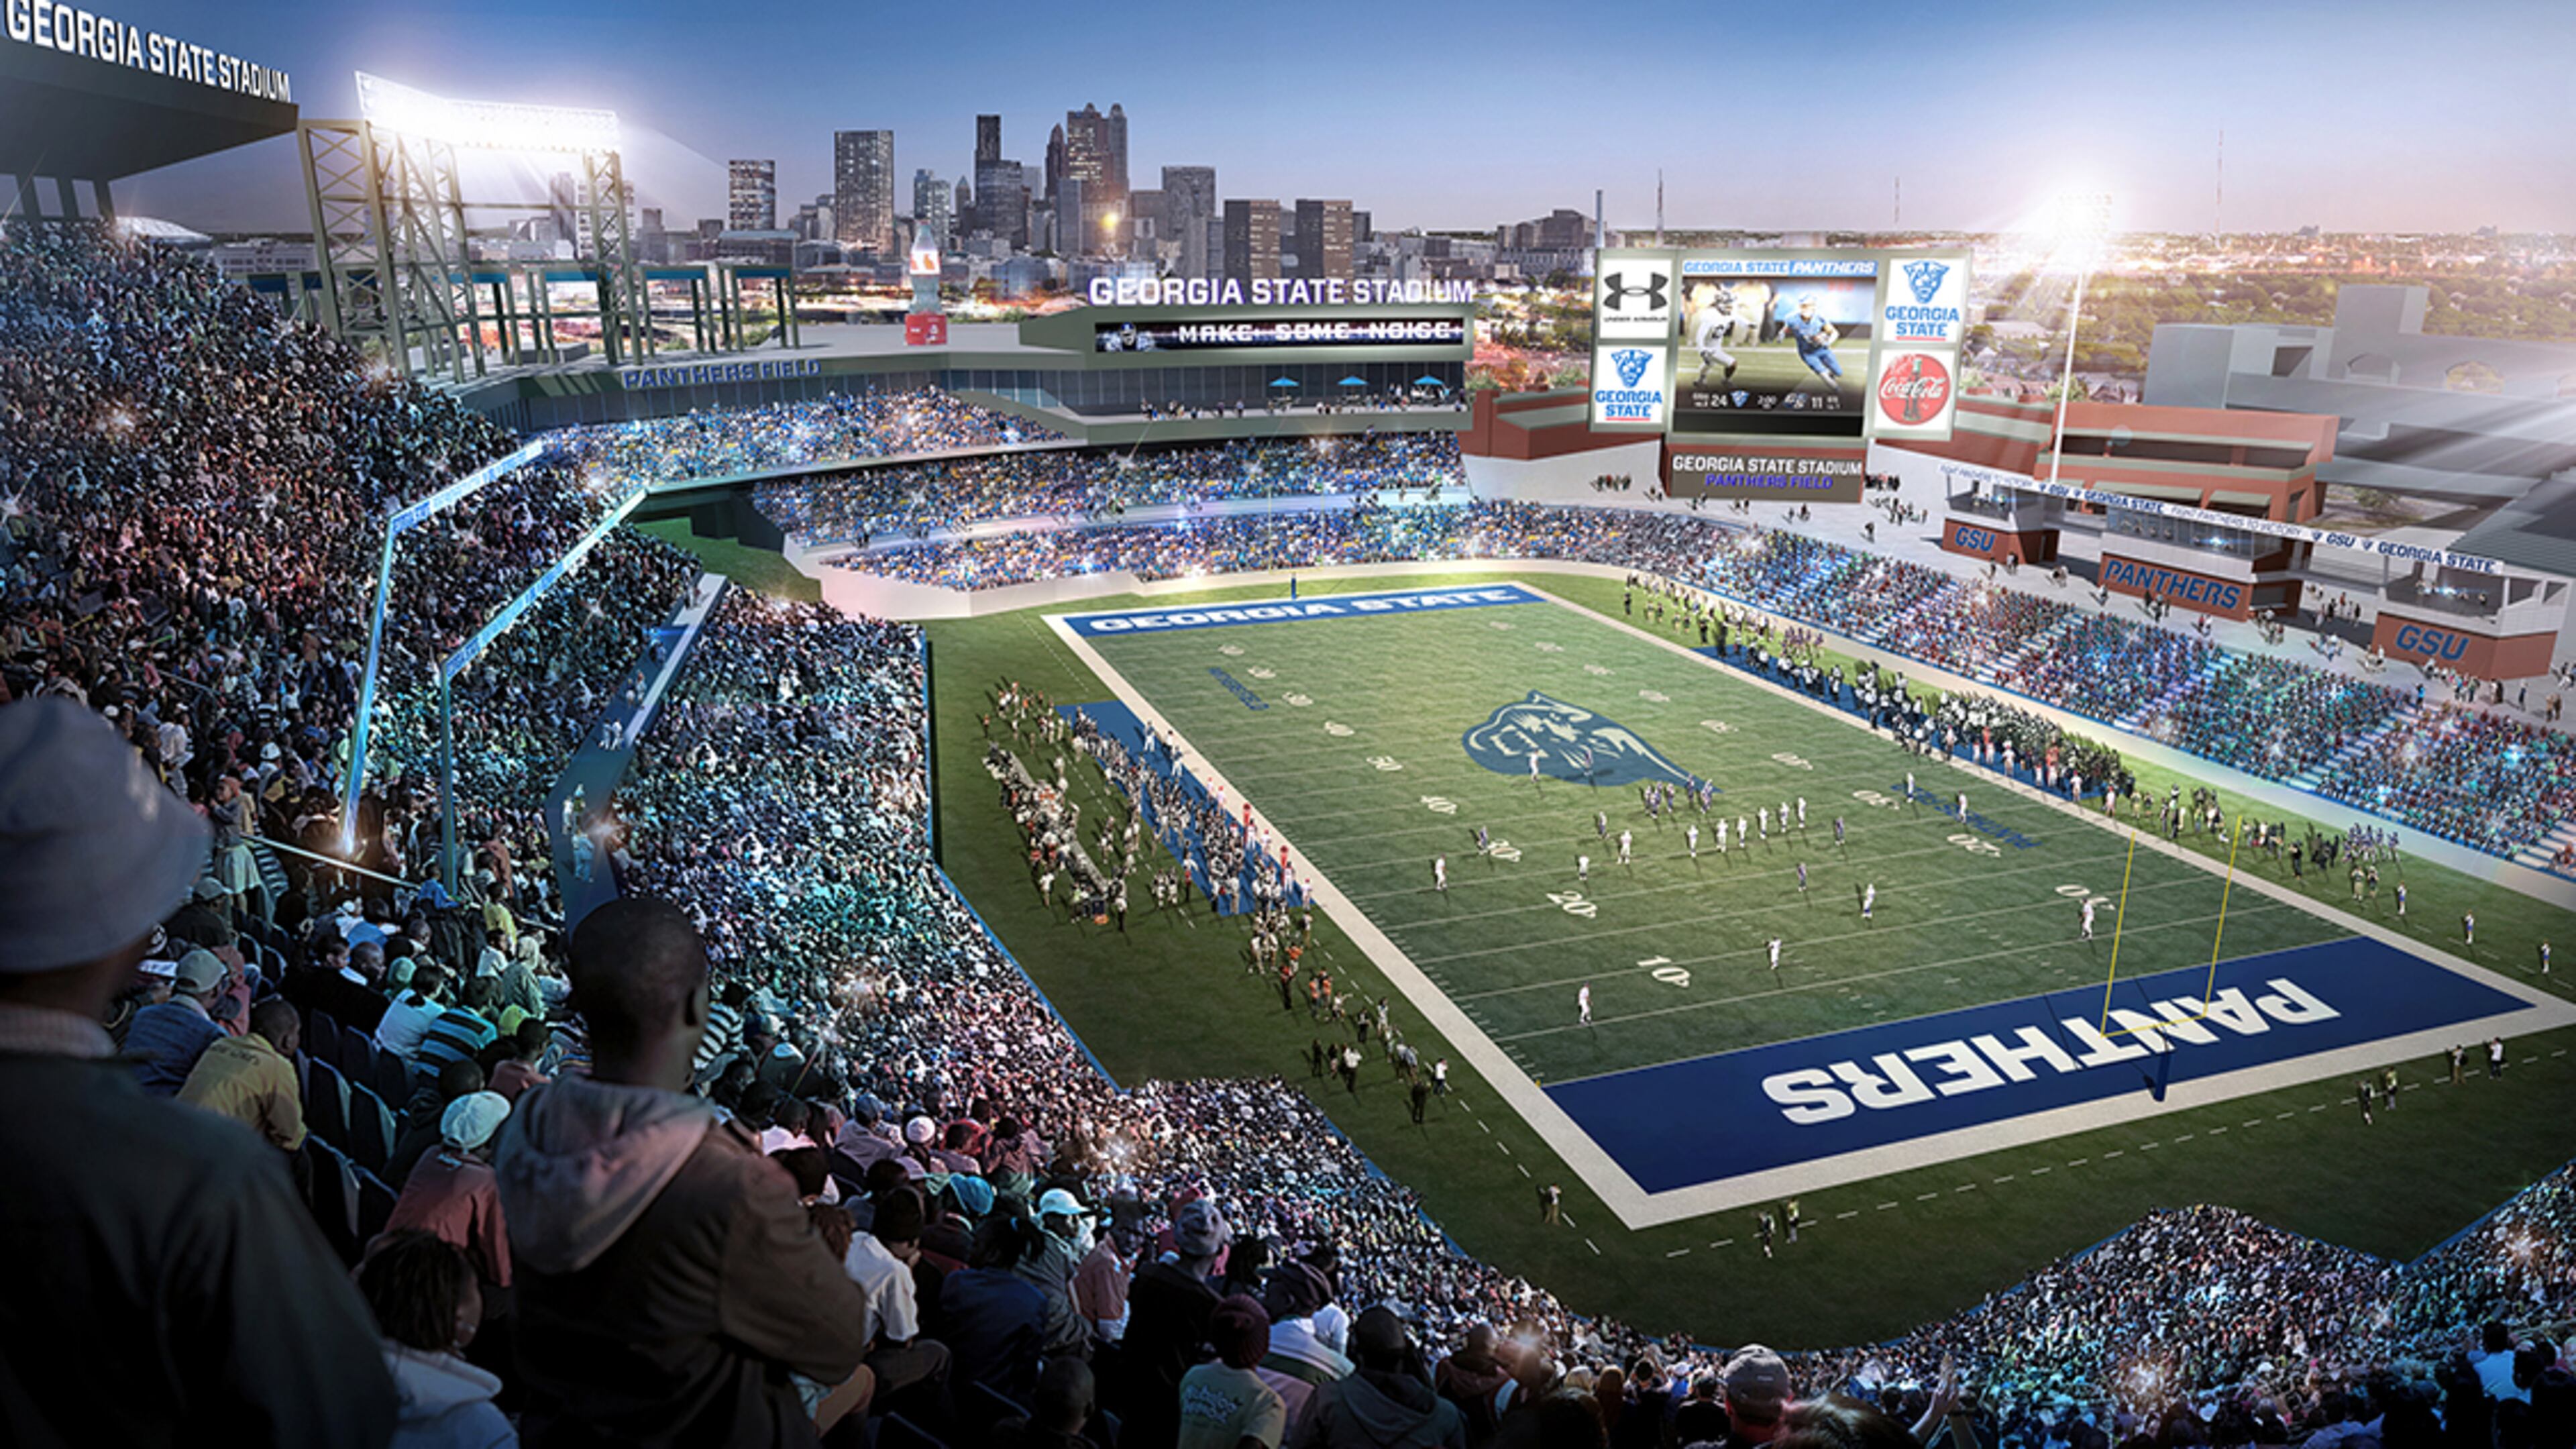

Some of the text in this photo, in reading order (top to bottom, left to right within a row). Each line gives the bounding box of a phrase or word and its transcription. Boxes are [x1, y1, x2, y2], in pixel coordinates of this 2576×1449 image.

[5, 0, 291, 103] GEORGIA STATE STADIUM
[1683, 260, 1876, 274] GEORGIA STATE PANTHERS
[1088, 278, 1475, 305] GEORGIA STATE STADIUM
[1885, 306, 1960, 322] GEORGIA
[1177, 321, 1451, 343] MAKE SOME NOISE
[1896, 322, 1948, 337] STATE
[622, 359, 822, 390] PANTHERS FIELD
[1595, 390, 1662, 404] GEORGIA
[1605, 405, 1651, 418] STATE
[1672, 455, 1863, 476] GEORGIA STATE STADIUM
[1705, 474, 1833, 490] PANTHERS FIELD
[2084, 488, 2129, 508] GEORGIA
[2131, 499, 2164, 514] STATE
[1955, 526, 1996, 553] GSU
[2326, 531, 2496, 573] GSU GEORGIA STATE
[2104, 559, 2241, 609] PANTHERS
[1089, 589, 1520, 633] GEORGIA STATE
[2396, 624, 2469, 661] GSU
[1636, 955, 1691, 983] 10
[1761, 977, 2342, 1125] PANTHERS
